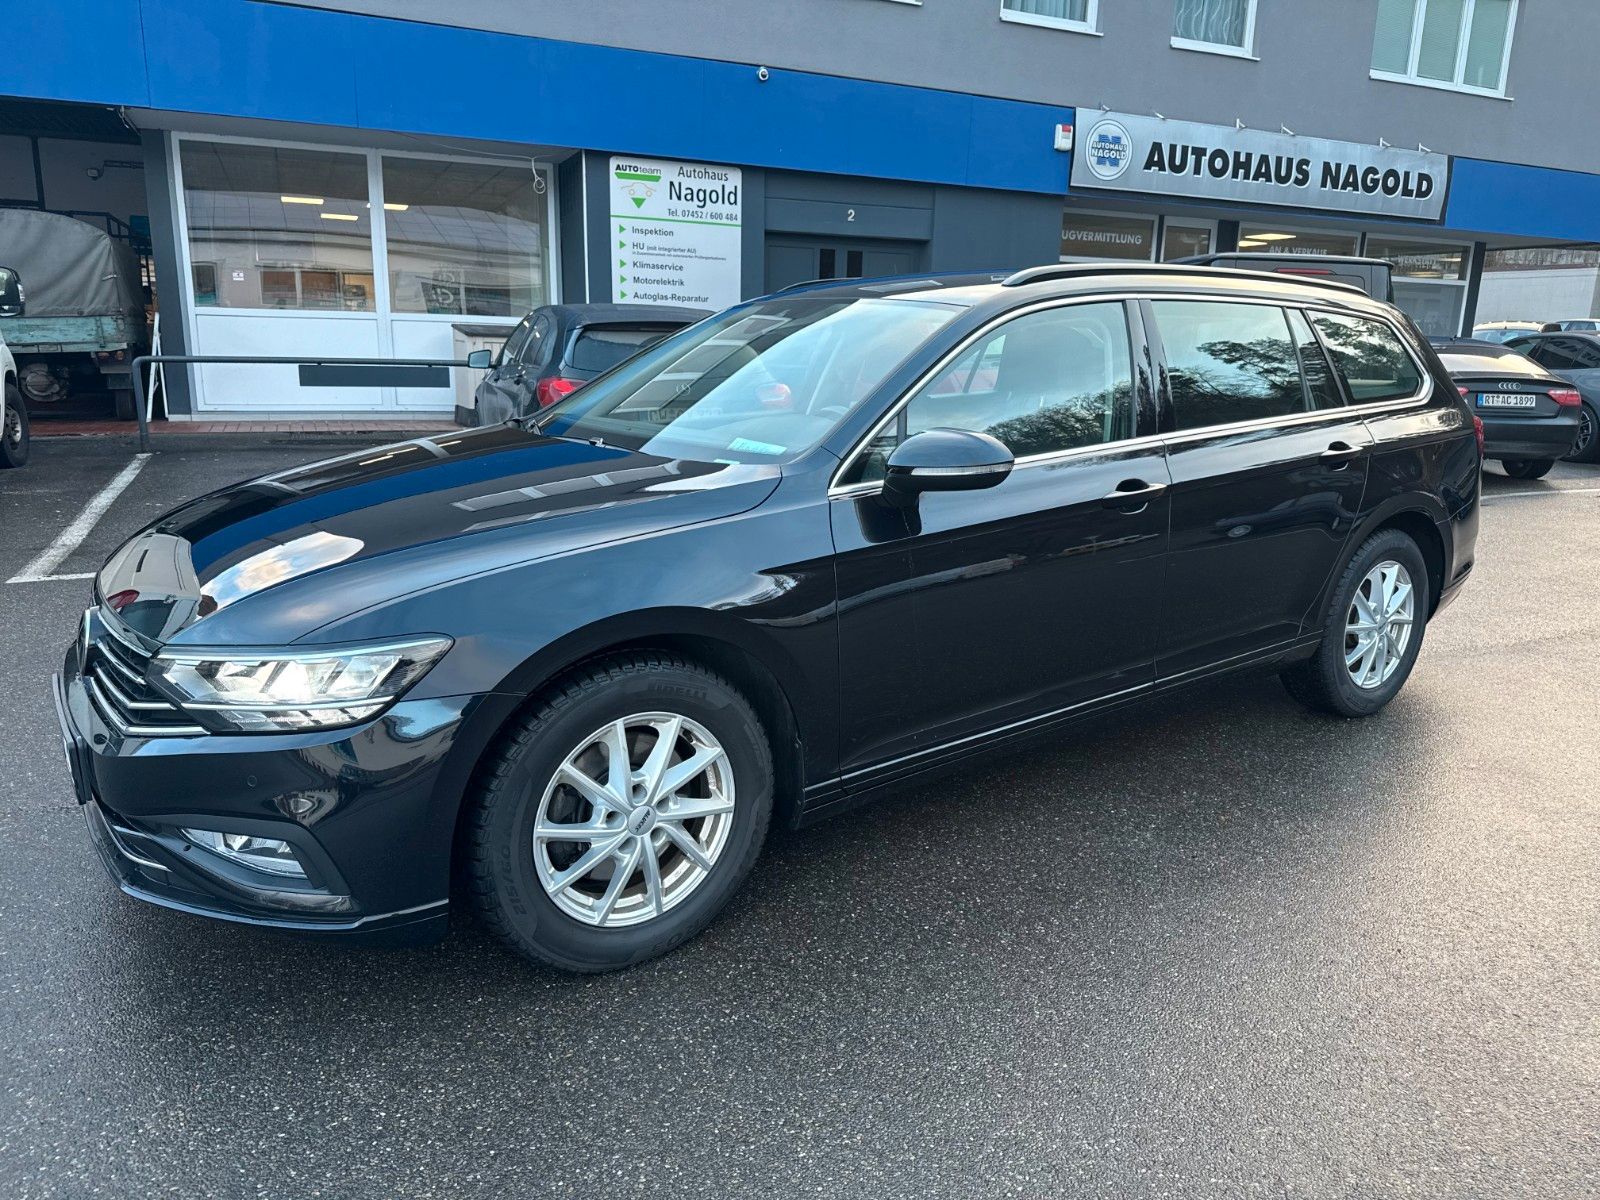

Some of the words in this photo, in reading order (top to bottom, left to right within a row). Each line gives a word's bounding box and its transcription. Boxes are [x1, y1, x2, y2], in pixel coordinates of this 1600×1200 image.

[1091, 140, 1128, 151] AUTOHAUS
[1091, 148, 1128, 160] NAGOLD
[615, 163, 662, 174] AUTOteam
[677, 166, 729, 181] Autohaus
[1143, 141, 1311, 187] AUTOHAUS
[1320, 161, 1434, 200] NAGOLD
[669, 181, 738, 209] Nagold
[668, 208, 680, 218] Tel.
[681, 209, 704, 219] 07452
[710, 211, 723, 221] 600
[725, 212, 738, 222] 484
[847, 209, 855, 222] 2
[631, 226, 674, 237] Inspektion
[1061, 229, 1142, 245] UGVERMITTLUNG
[632, 242, 645, 251] HU
[632, 260, 684, 272] Klimaservice
[633, 276, 685, 287] Motorelektrik
[633, 291, 709, 303] Autoglas-Reparatur
[1484, 395, 1496, 405] RT
[1500, 395, 1512, 405] AC
[1513, 396, 1535, 406] 1899
